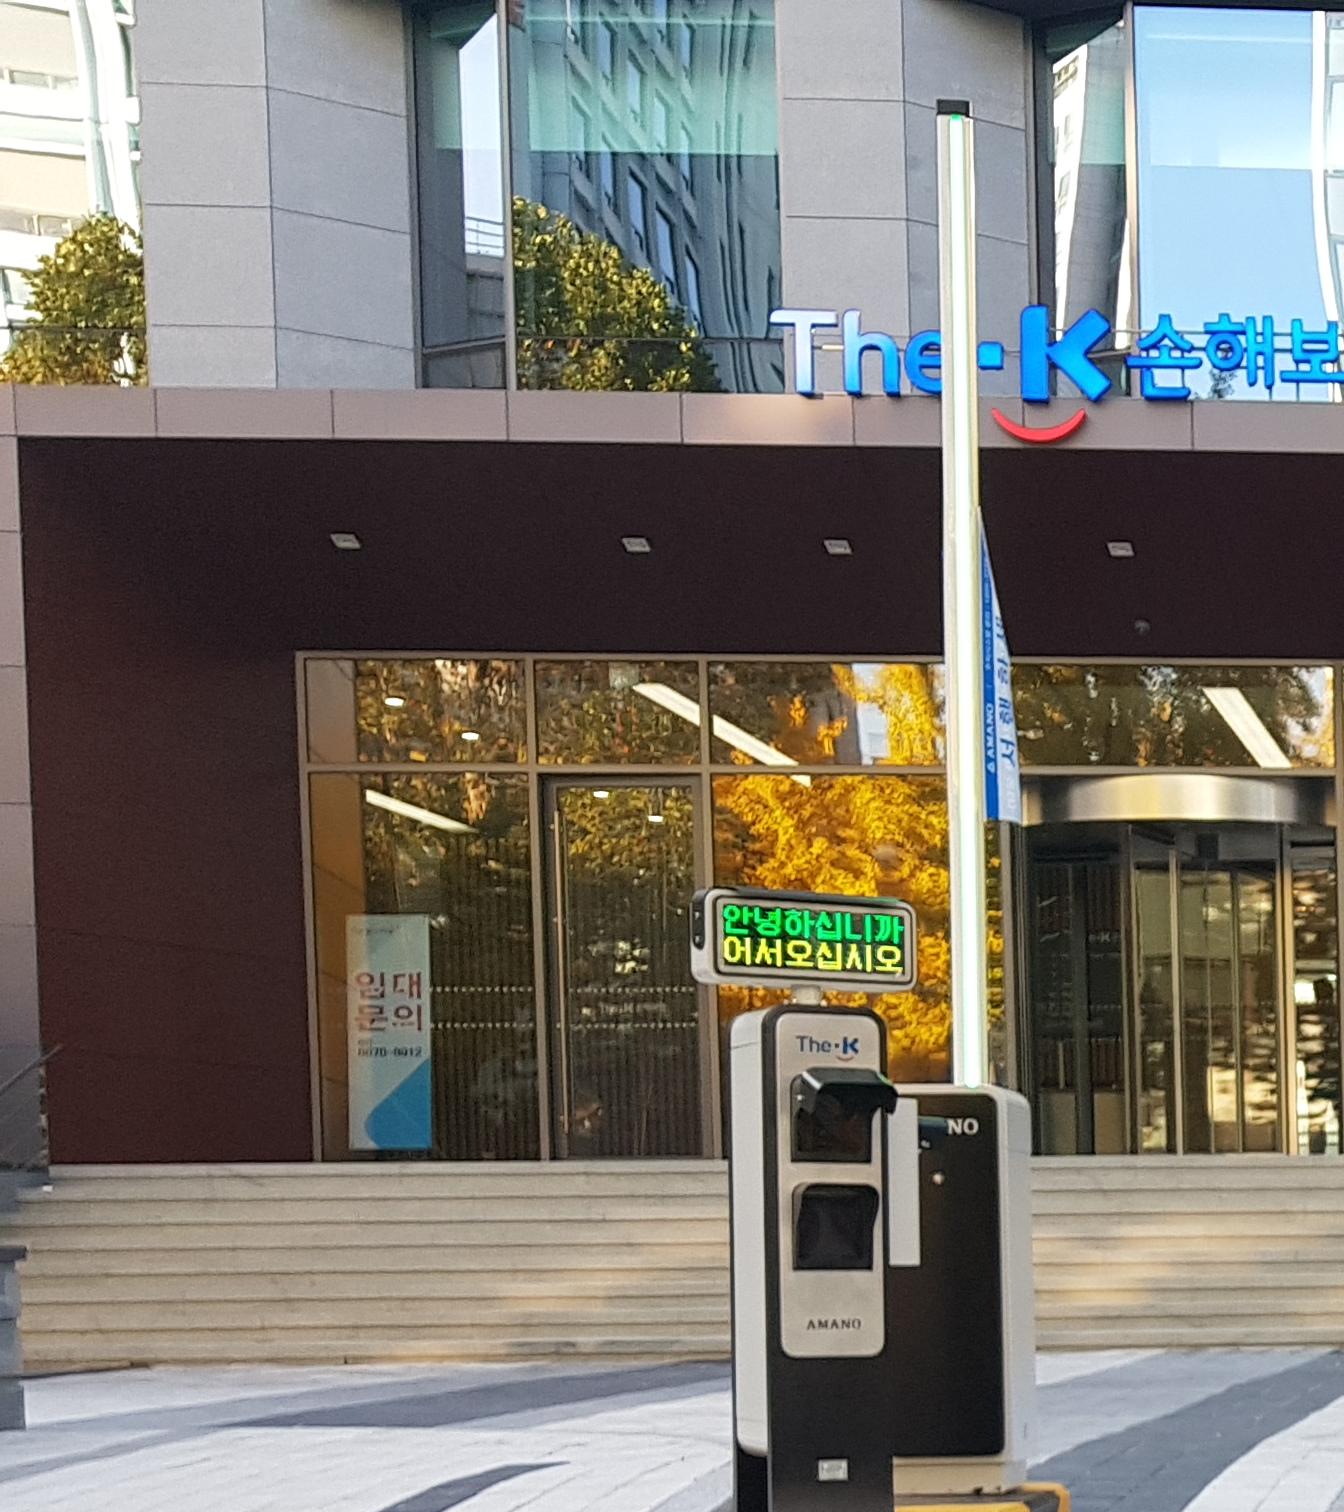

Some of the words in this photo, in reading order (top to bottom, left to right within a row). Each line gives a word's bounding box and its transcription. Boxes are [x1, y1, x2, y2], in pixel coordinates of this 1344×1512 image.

[985, 703, 996, 760] AMANO
[723, 904, 904, 944] 안녕하십니까
[723, 936, 903, 973] 어서오십시오
[356, 971, 422, 999] 임대
[355, 1004, 422, 1032] 문의
[807, 1318, 862, 1330] AMANO
